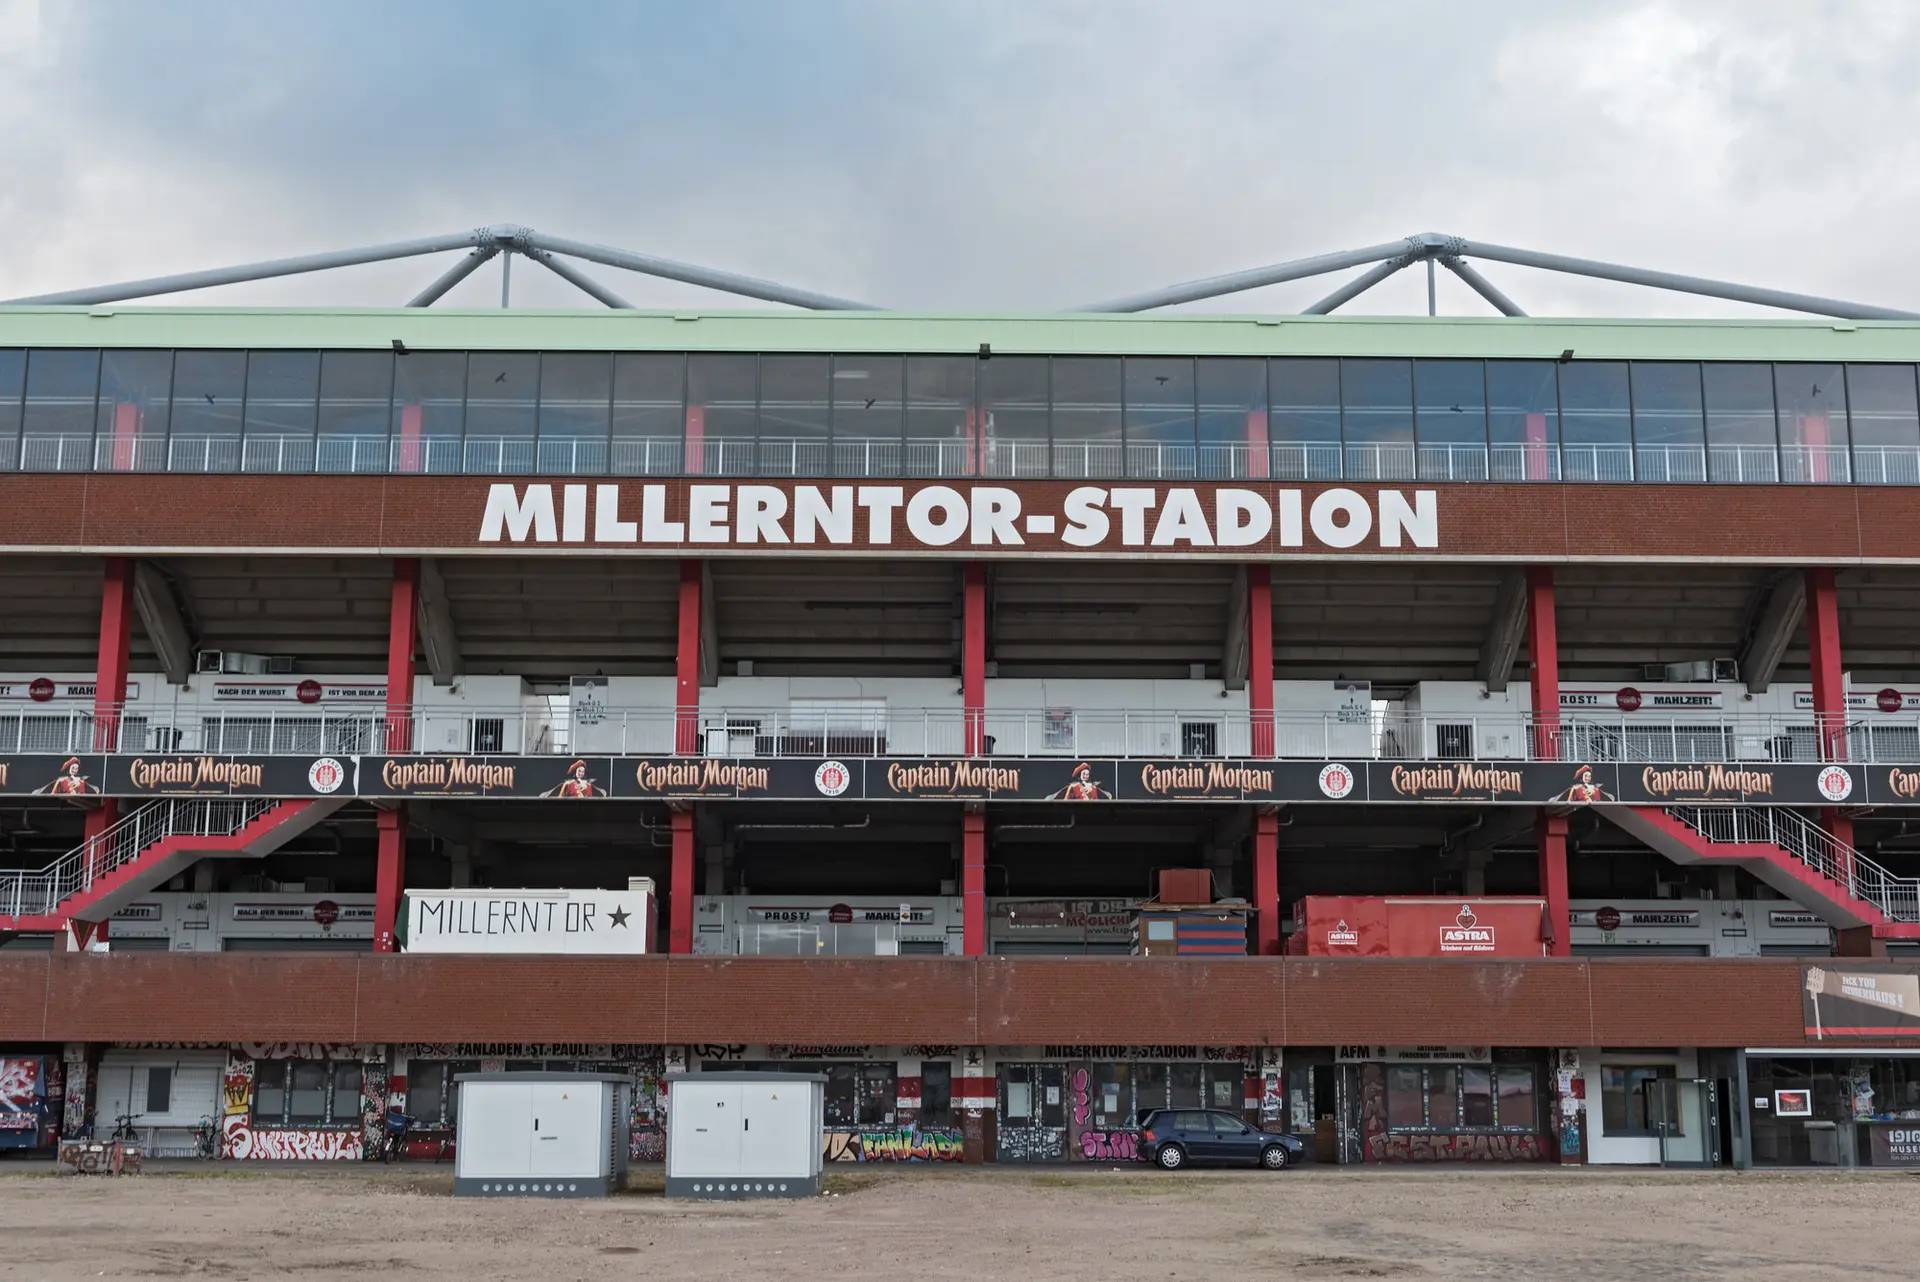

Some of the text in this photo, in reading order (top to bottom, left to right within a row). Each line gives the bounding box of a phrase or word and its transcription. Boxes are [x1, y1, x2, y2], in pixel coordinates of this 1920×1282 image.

[478, 483, 1439, 548] MILLERNTOR-STADION
[1560, 695, 1713, 705] ROST! MAHLZEIT!
[130, 757, 261, 788] Captain Morgan
[382, 758, 513, 789] Captain Morgan
[637, 760, 768, 791] Captain Morgan
[888, 761, 1019, 792] Captain Morgan
[1142, 763, 1273, 794] Captain Morgan
[1391, 764, 1522, 795] Captain Morgan
[1642, 765, 1773, 796] Captain Morgan
[419, 900, 596, 935] MILLERNTOR
[765, 912, 923, 921] PROST! MAHLZIT!
[1632, 915, 1690, 923] MAHLZEIT!
[1445, 931, 1490, 940] ASTRA
[1858, 977, 1876, 989] YOU
[458, 1043, 522, 1056] FANLADEN
[1340, 1045, 1370, 1058] AFM
[1891, 1145, 1920, 1153] MUSE
